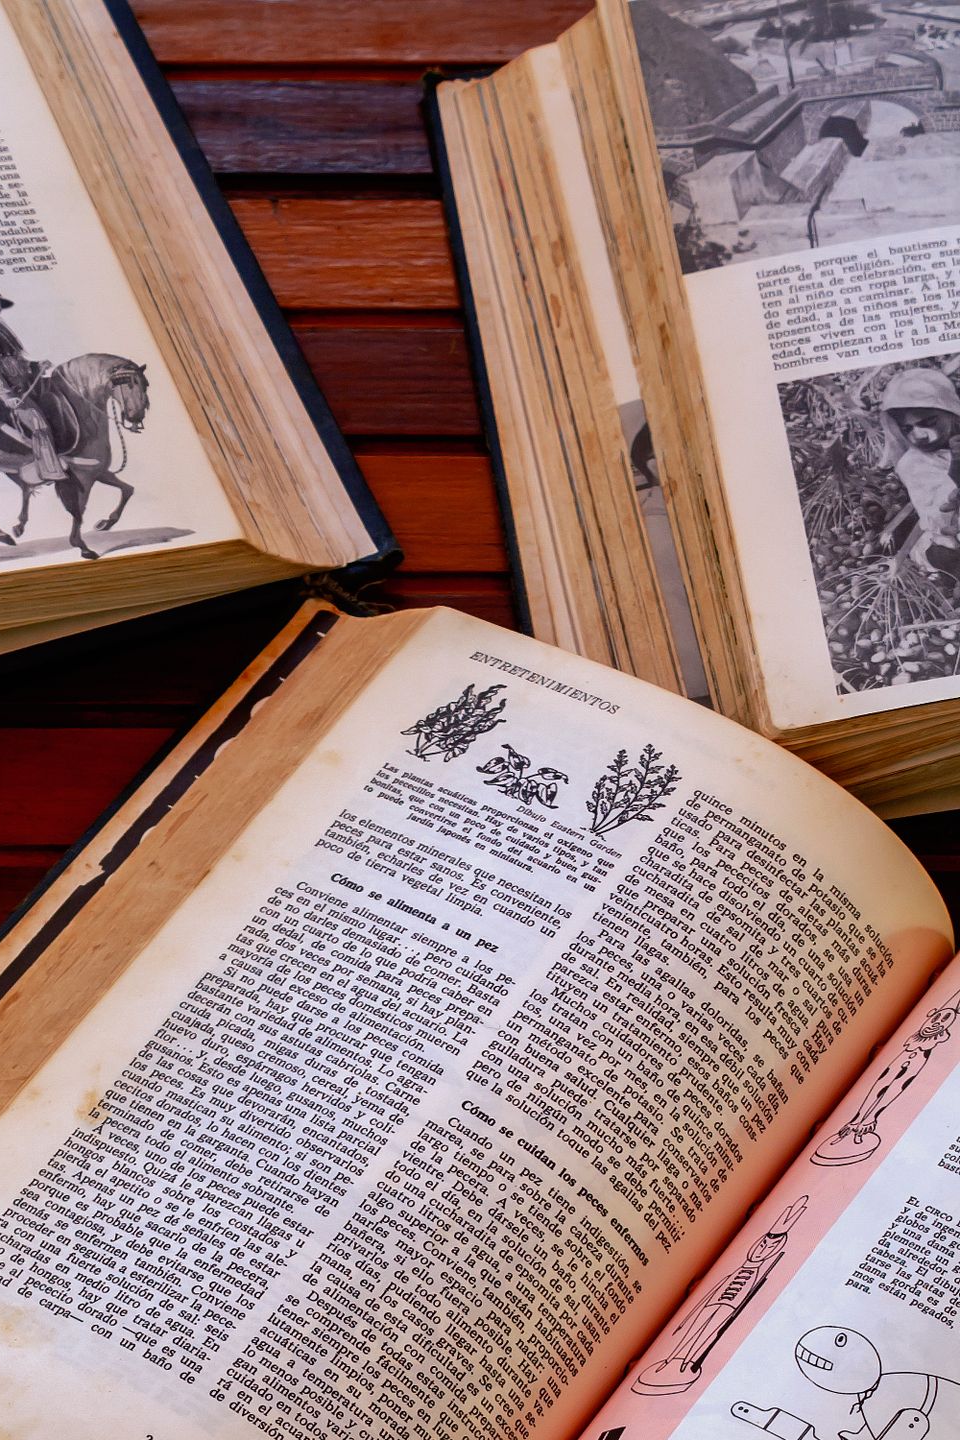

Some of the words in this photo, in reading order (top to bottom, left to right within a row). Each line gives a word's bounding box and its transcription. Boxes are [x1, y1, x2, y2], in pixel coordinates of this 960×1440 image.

[772, 354, 829, 372] hombres
[836, 348, 860, 359] van
[867, 341, 904, 354] todos
[910, 337, 931, 347] los
[468, 651, 621, 715] ENTRETENIMIENTOS
[381, 762, 400, 774] Las
[400, 771, 435, 791] plantas
[436, 786, 478, 807] acuáticas
[479, 804, 540, 834] proporcionan
[543, 831, 555, 840] el
[556, 838, 594, 858] oxígeno
[596, 857, 615, 870] que
[515, 802, 547, 823] Dibujo
[549, 820, 586, 841] Eastern
[589, 834, 623, 859] Garden
[330, 873, 364, 893] Cómo
[367, 890, 383, 901] se
[386, 898, 437, 925] alimenta
[440, 922, 451, 931] a
[455, 928, 472, 941] un
[474, 938, 500, 953] pez
[461, 1100, 497, 1127] Cómo
[498, 1126, 514, 1139] se
[516, 1138, 557, 1171] cuidan
[557, 1167, 577, 1187] los
[576, 1186, 609, 1218] peces
[610, 1217, 650, 1267] enfermos
[16, 1282, 33, 1299] de
[90, 1324, 113, 1340] con
[119, 1337, 136, 1352] un
[142, 1347, 173, 1371] baño
[179, 1371, 196, 1385] de
